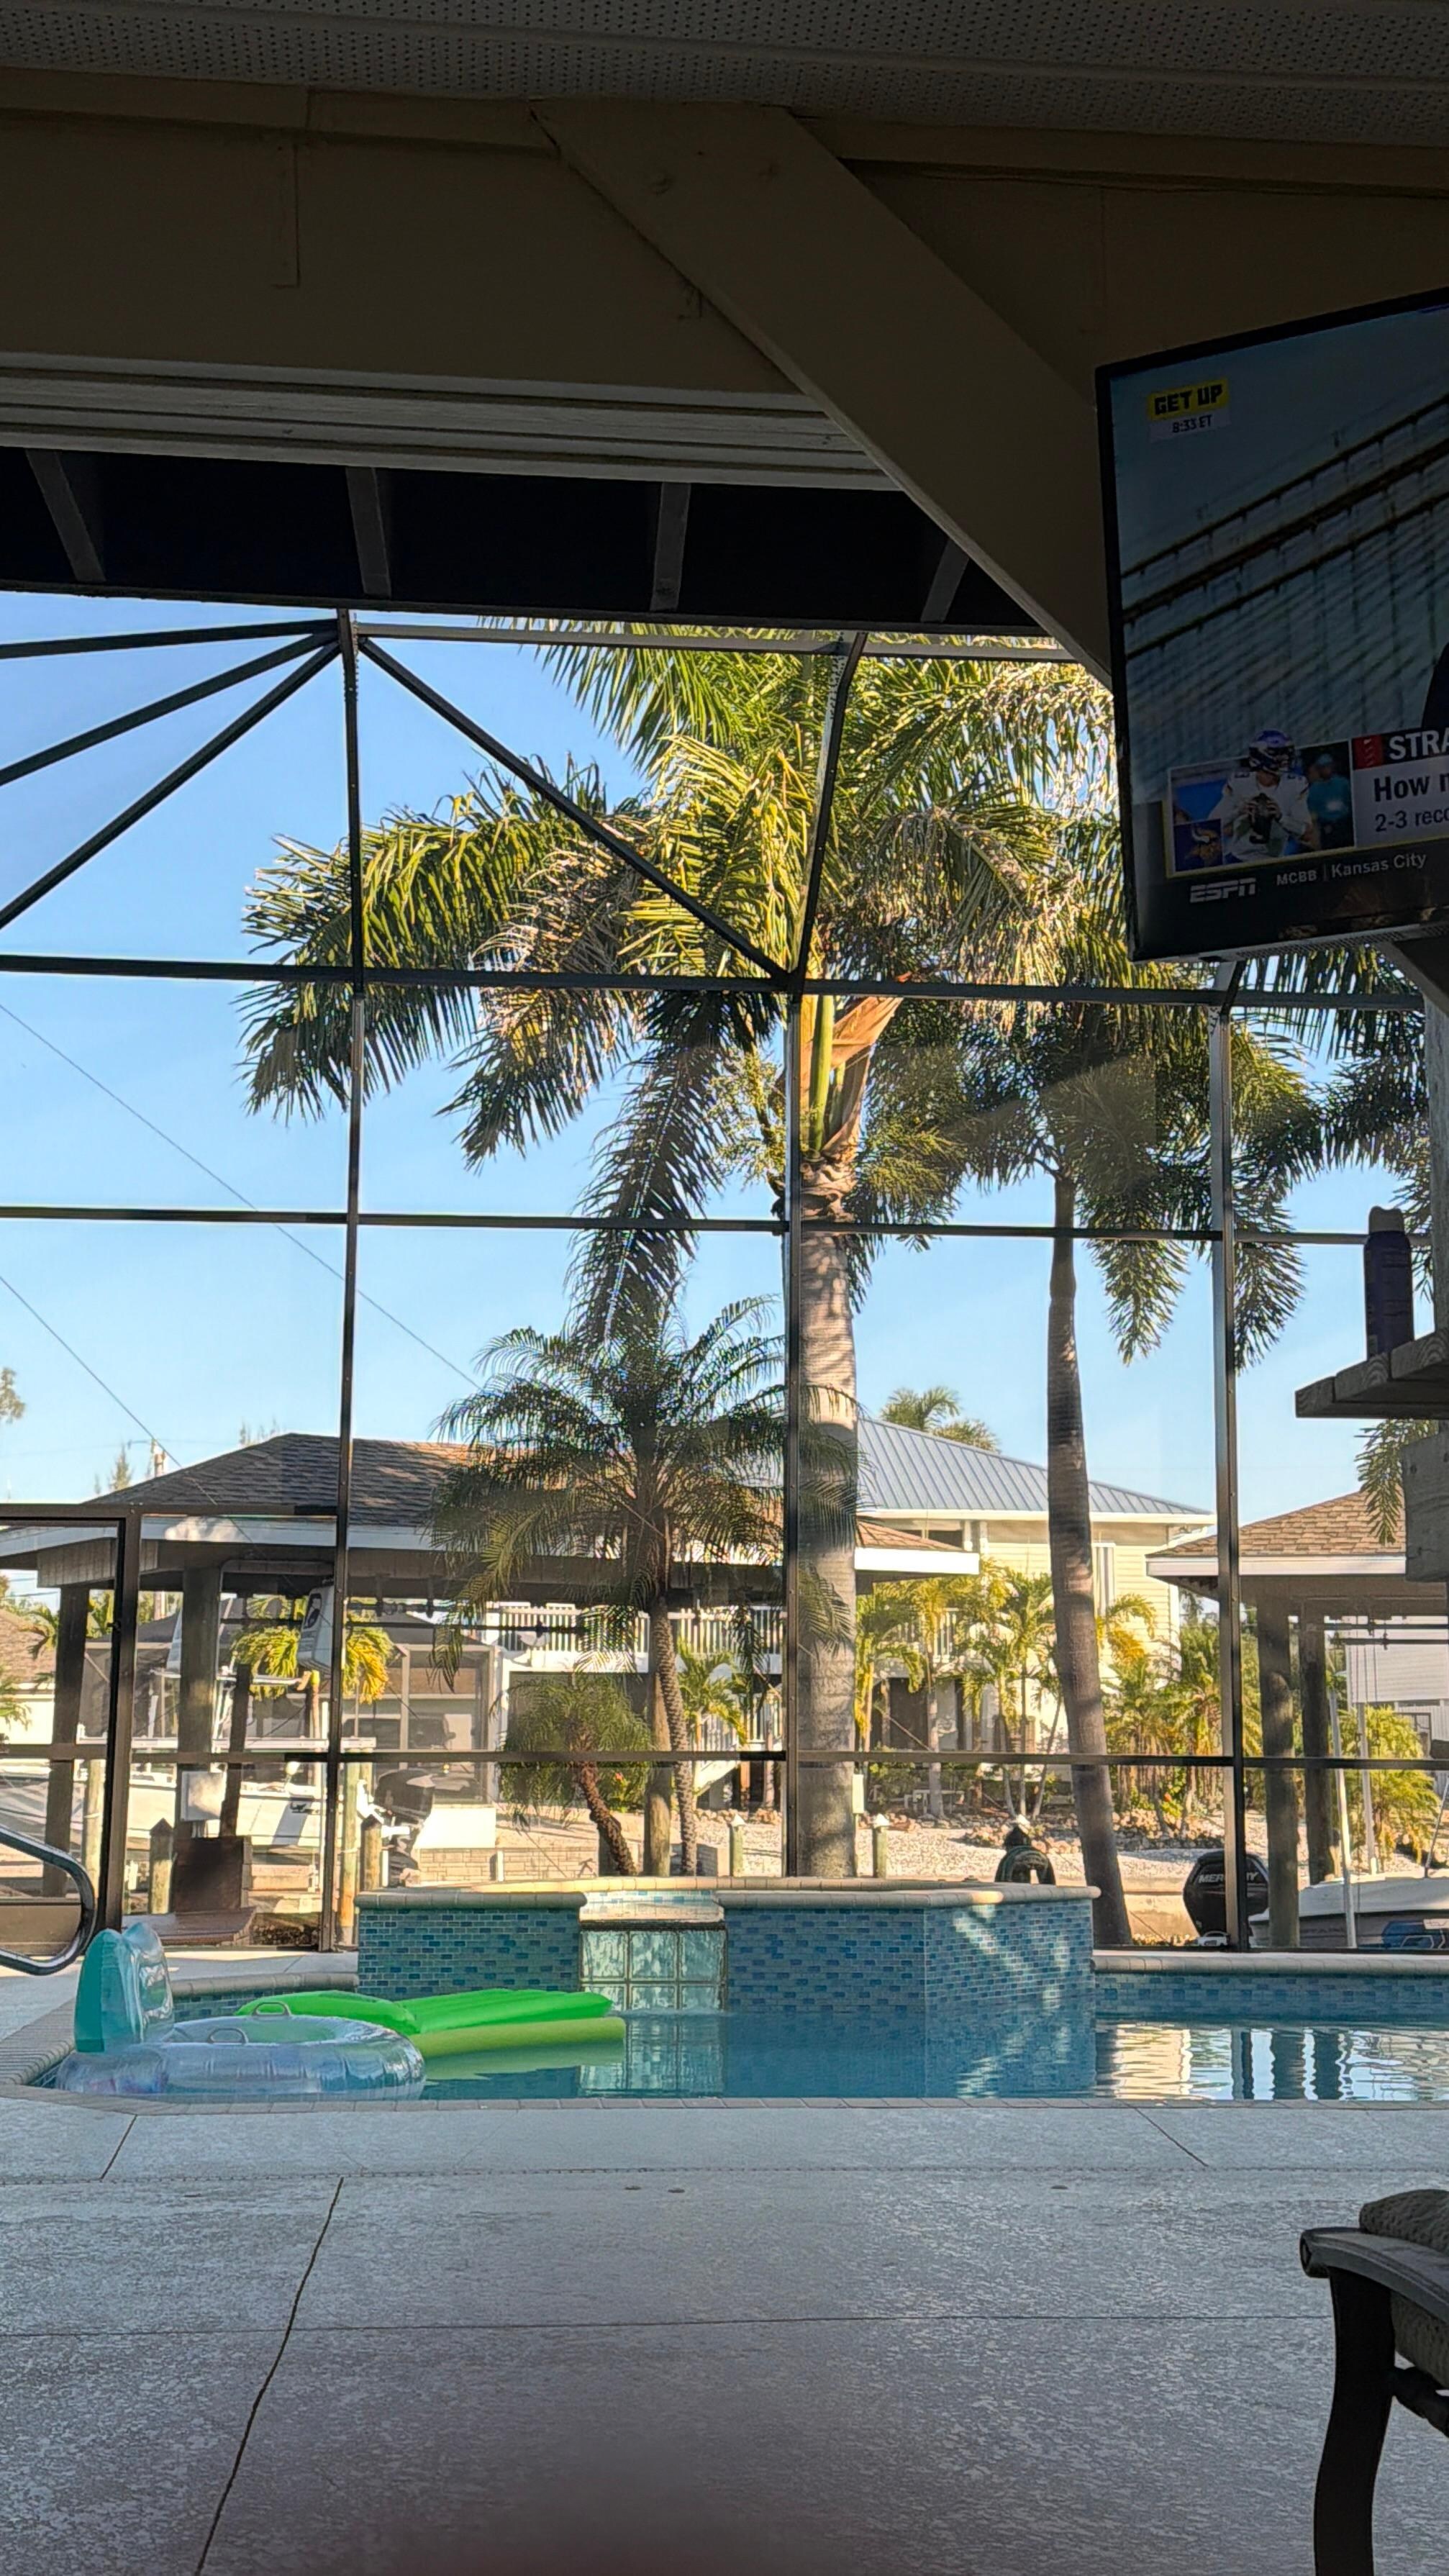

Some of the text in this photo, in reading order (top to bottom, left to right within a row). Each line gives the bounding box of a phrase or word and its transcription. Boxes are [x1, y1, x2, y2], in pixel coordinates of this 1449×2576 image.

[1155, 384, 1222, 414] GET UP
[1172, 414, 1212, 433] 8:33 ET
[1374, 776, 1430, 802] How
[1375, 810, 1407, 832] 2-3
[1276, 853, 1426, 885] MCBB Kansas City
[1189, 877, 1257, 903] ESPN
[1199, 1871, 1258, 1883] MERY
